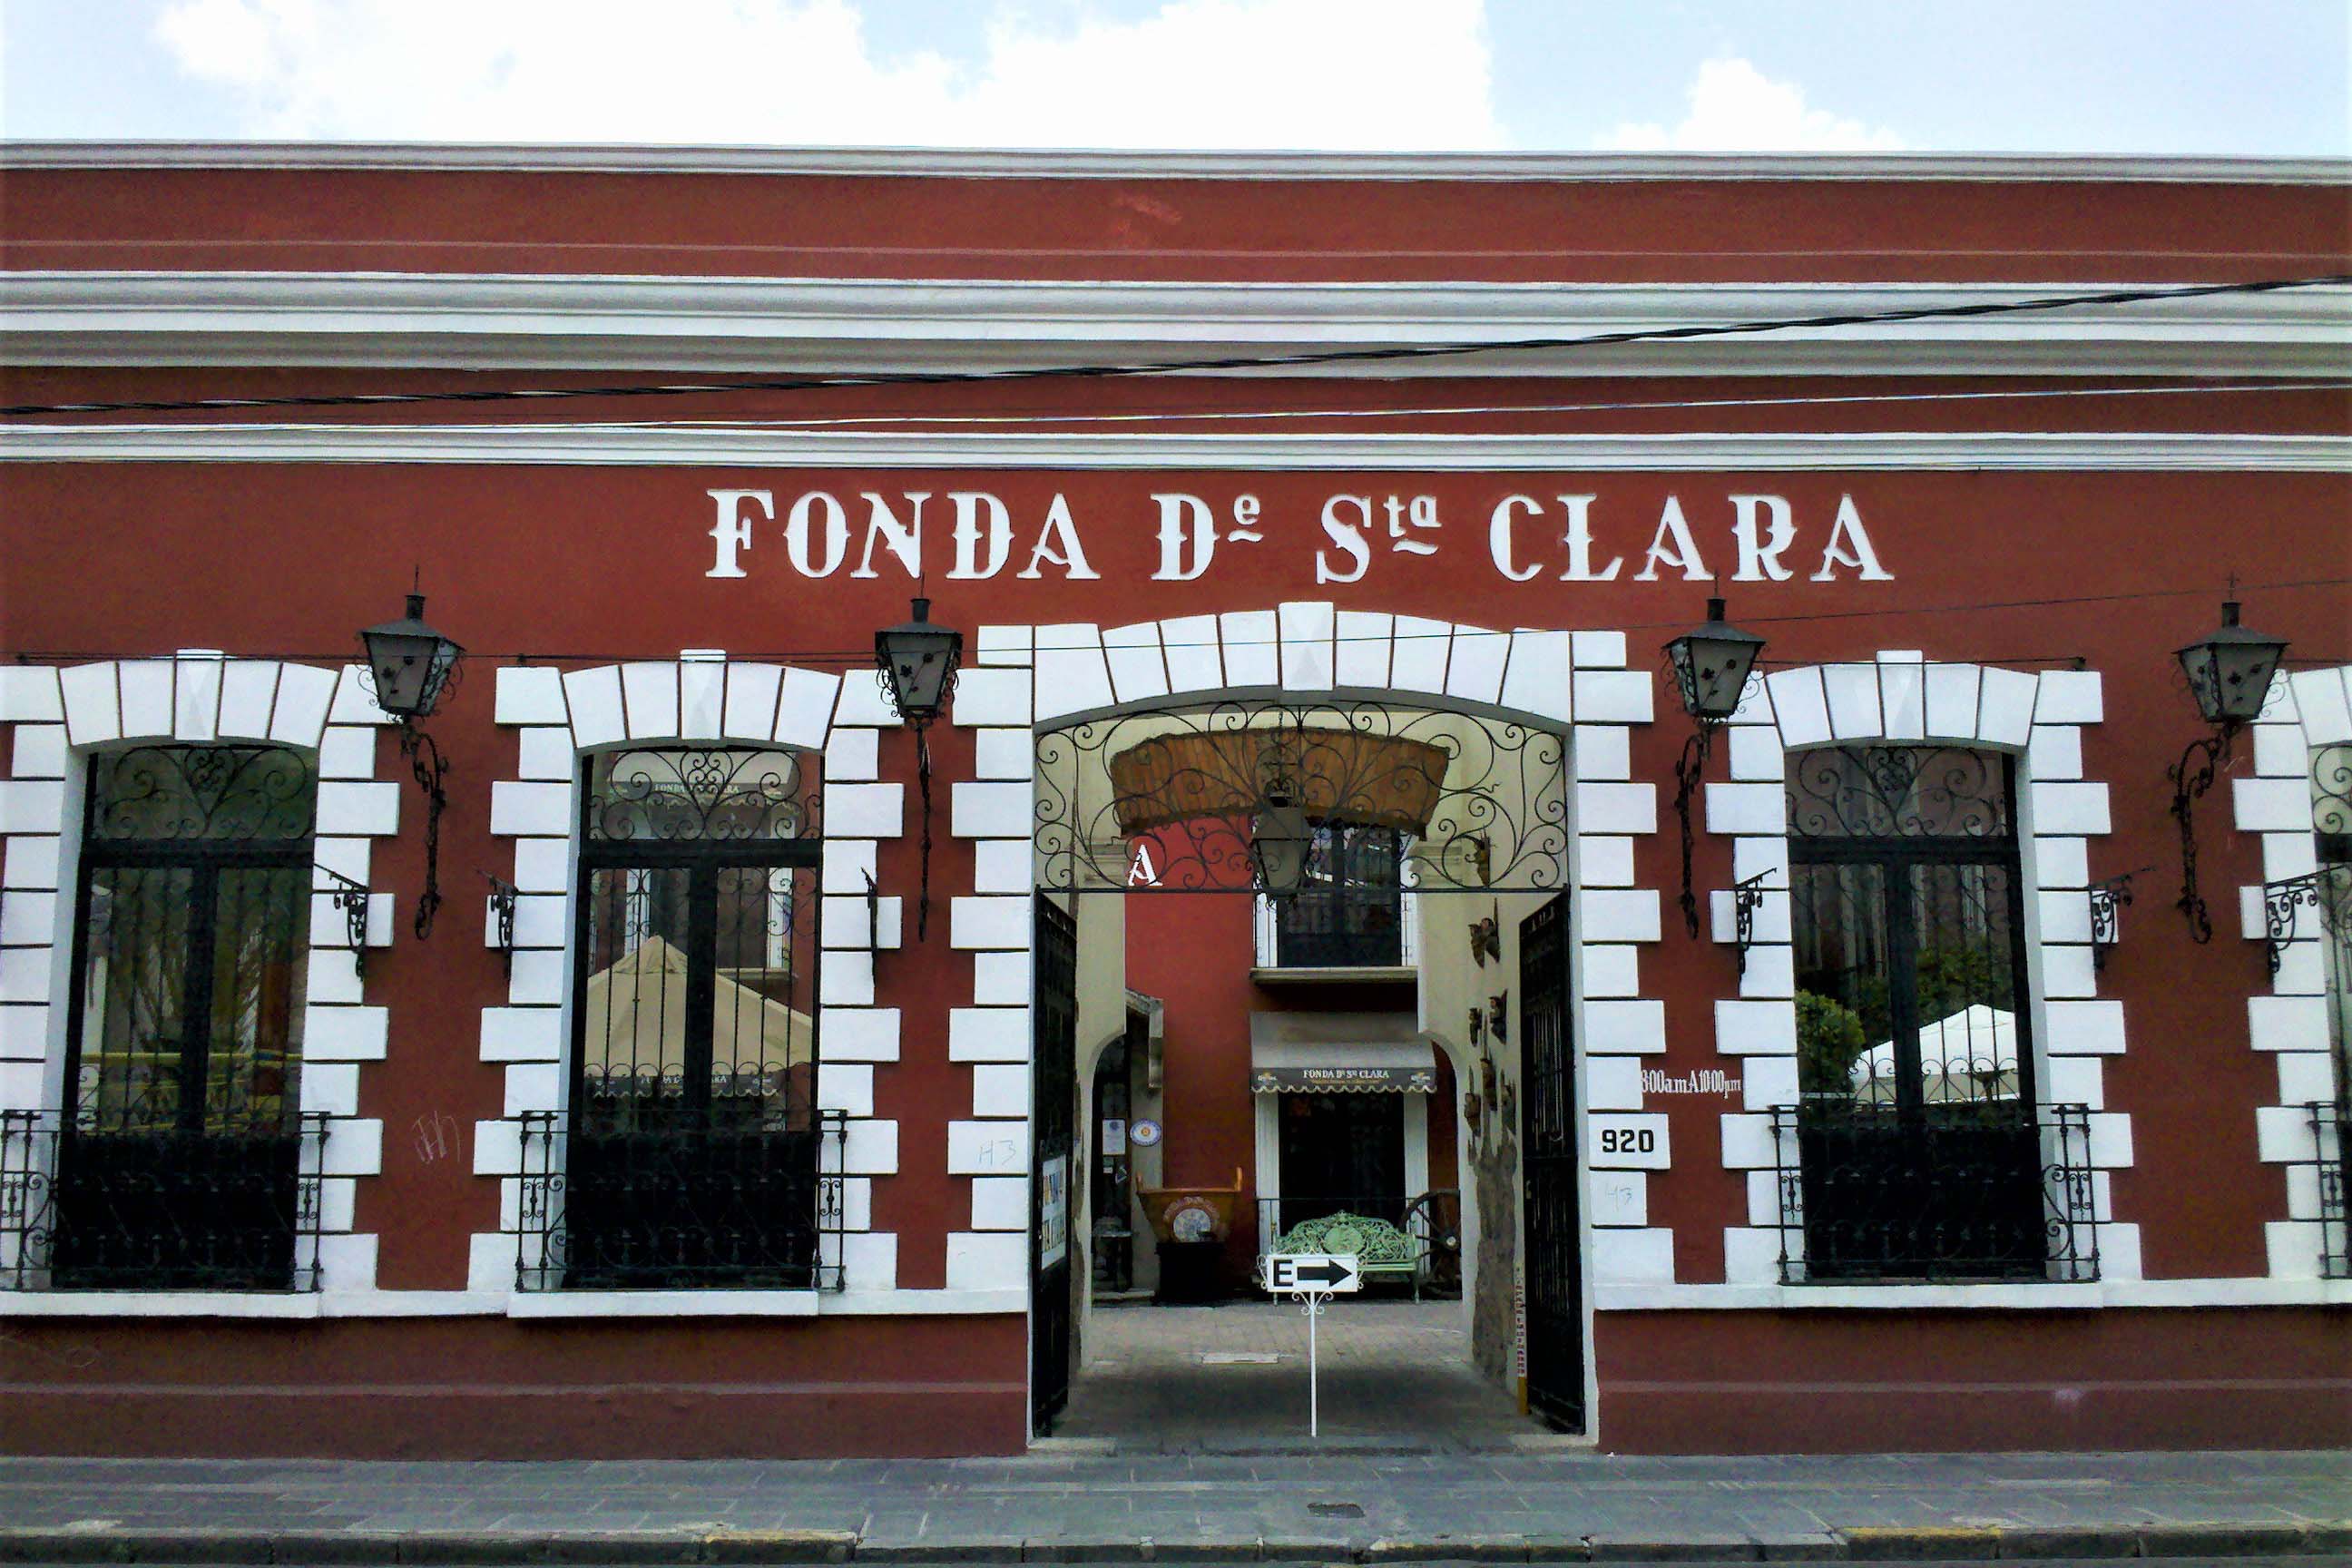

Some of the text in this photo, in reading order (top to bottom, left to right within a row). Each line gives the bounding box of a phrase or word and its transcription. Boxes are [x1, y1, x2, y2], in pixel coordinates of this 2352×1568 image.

[705, 489, 1101, 580] FONDA
[1316, 493, 1442, 584] Sta
[1489, 493, 1895, 583] CLARA
[1303, 1069, 1335, 1079] FONDA
[1359, 1069, 1389, 1079] CLARA
[1602, 1129, 1654, 1153] 920
[1273, 1259, 1294, 1287] E
